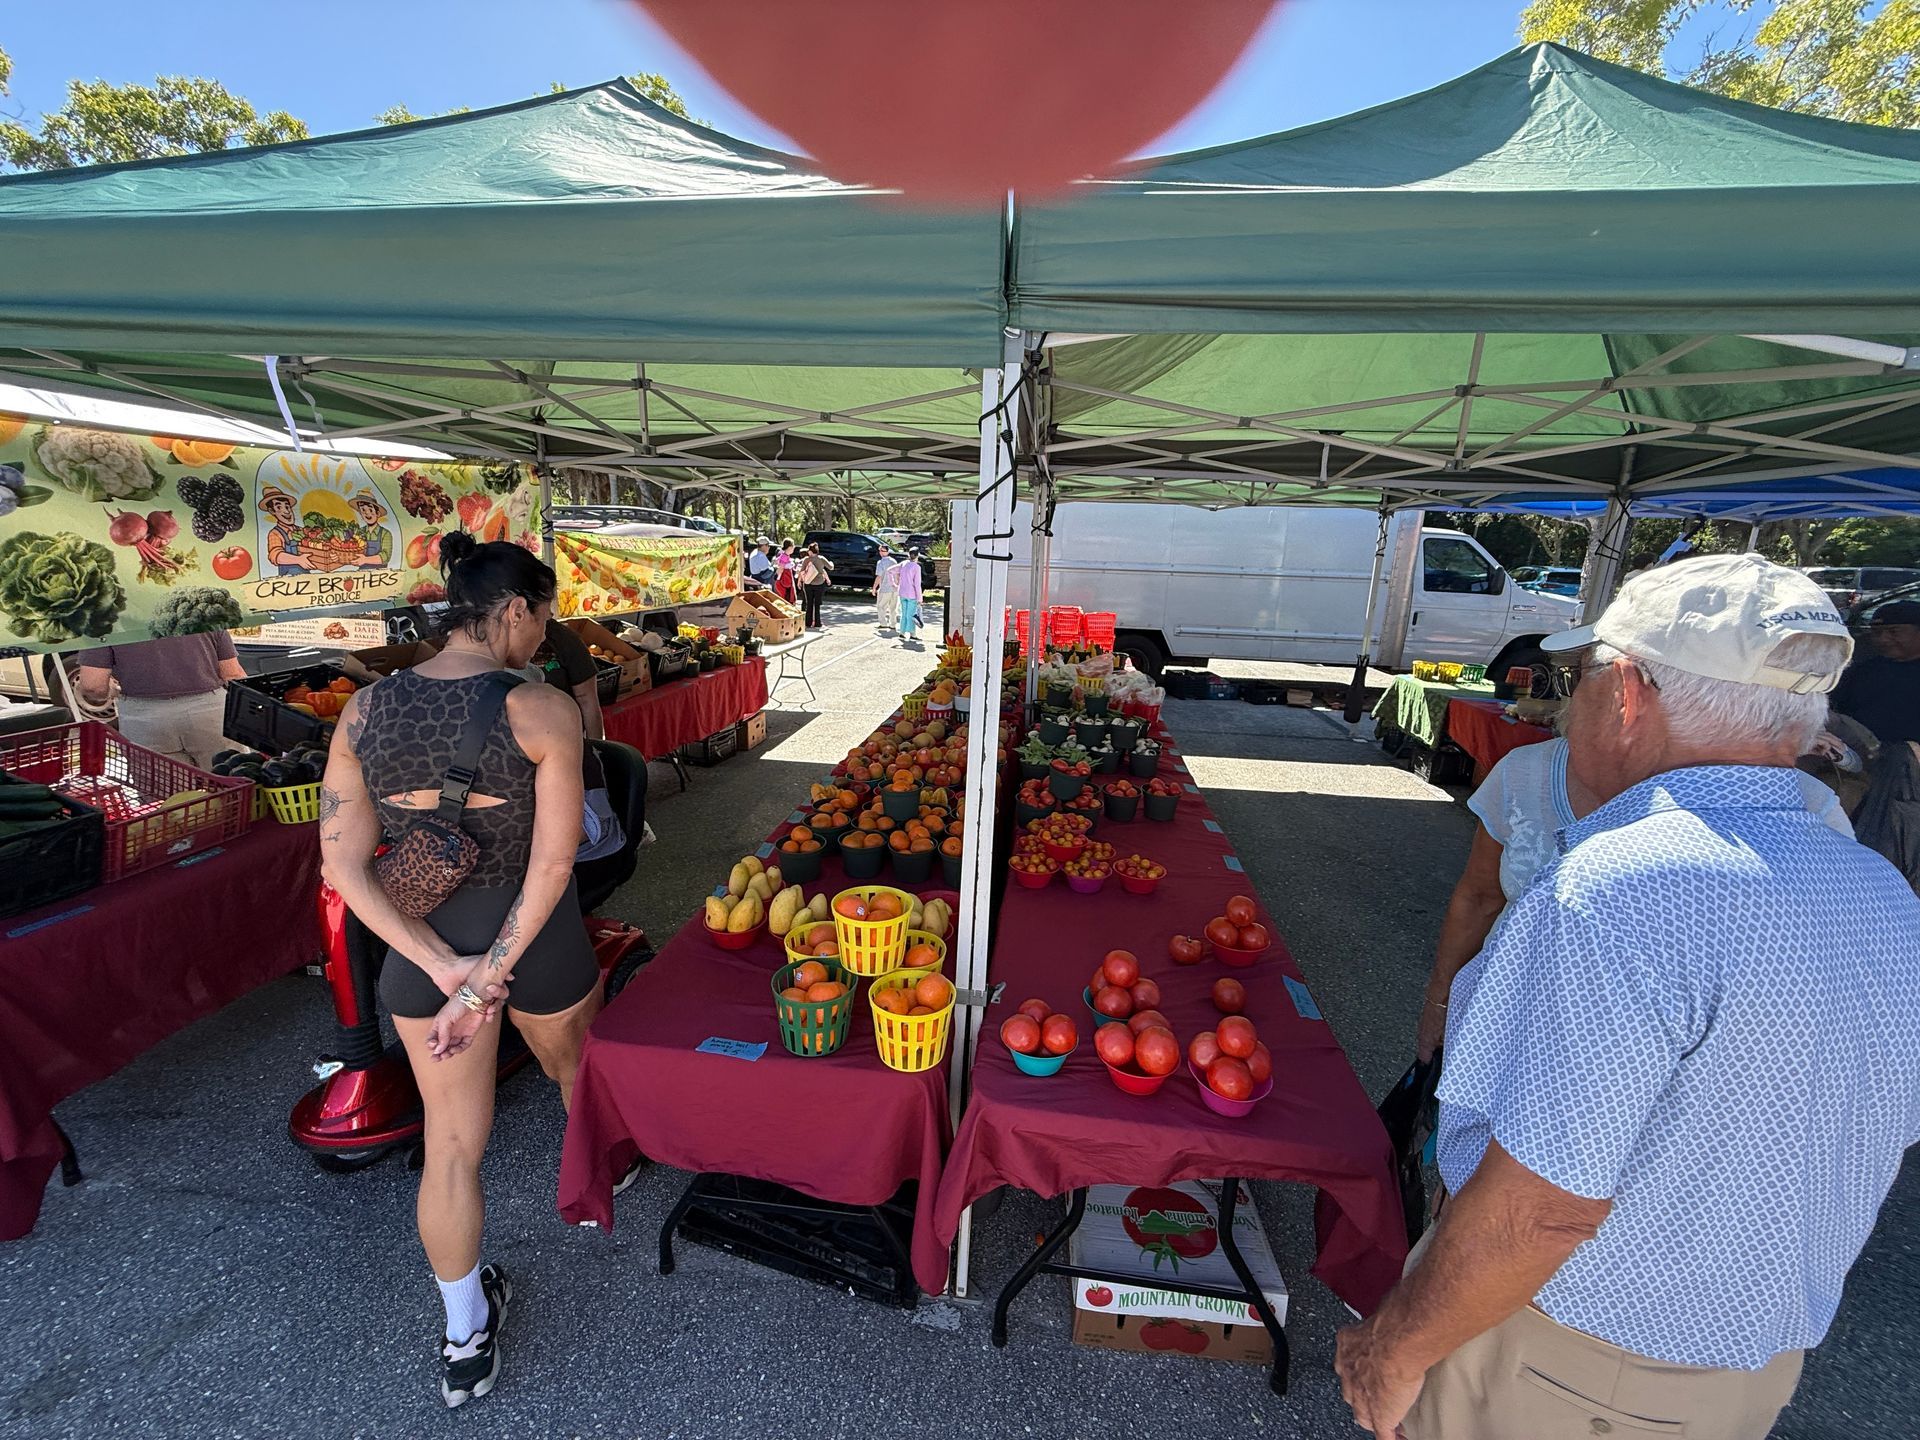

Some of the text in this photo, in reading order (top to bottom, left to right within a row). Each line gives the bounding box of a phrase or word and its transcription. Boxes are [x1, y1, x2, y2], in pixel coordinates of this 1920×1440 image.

[256, 573, 398, 598] CRUZ BROTHERS
[310, 591, 361, 605] PRODUCE
[1757, 611, 1809, 630] USGA
[1086, 1202, 1142, 1225] Tomatoe
[1165, 1209, 1218, 1230] Carolina
[1118, 1291, 1247, 1319] MOUNTAIN GROWN
